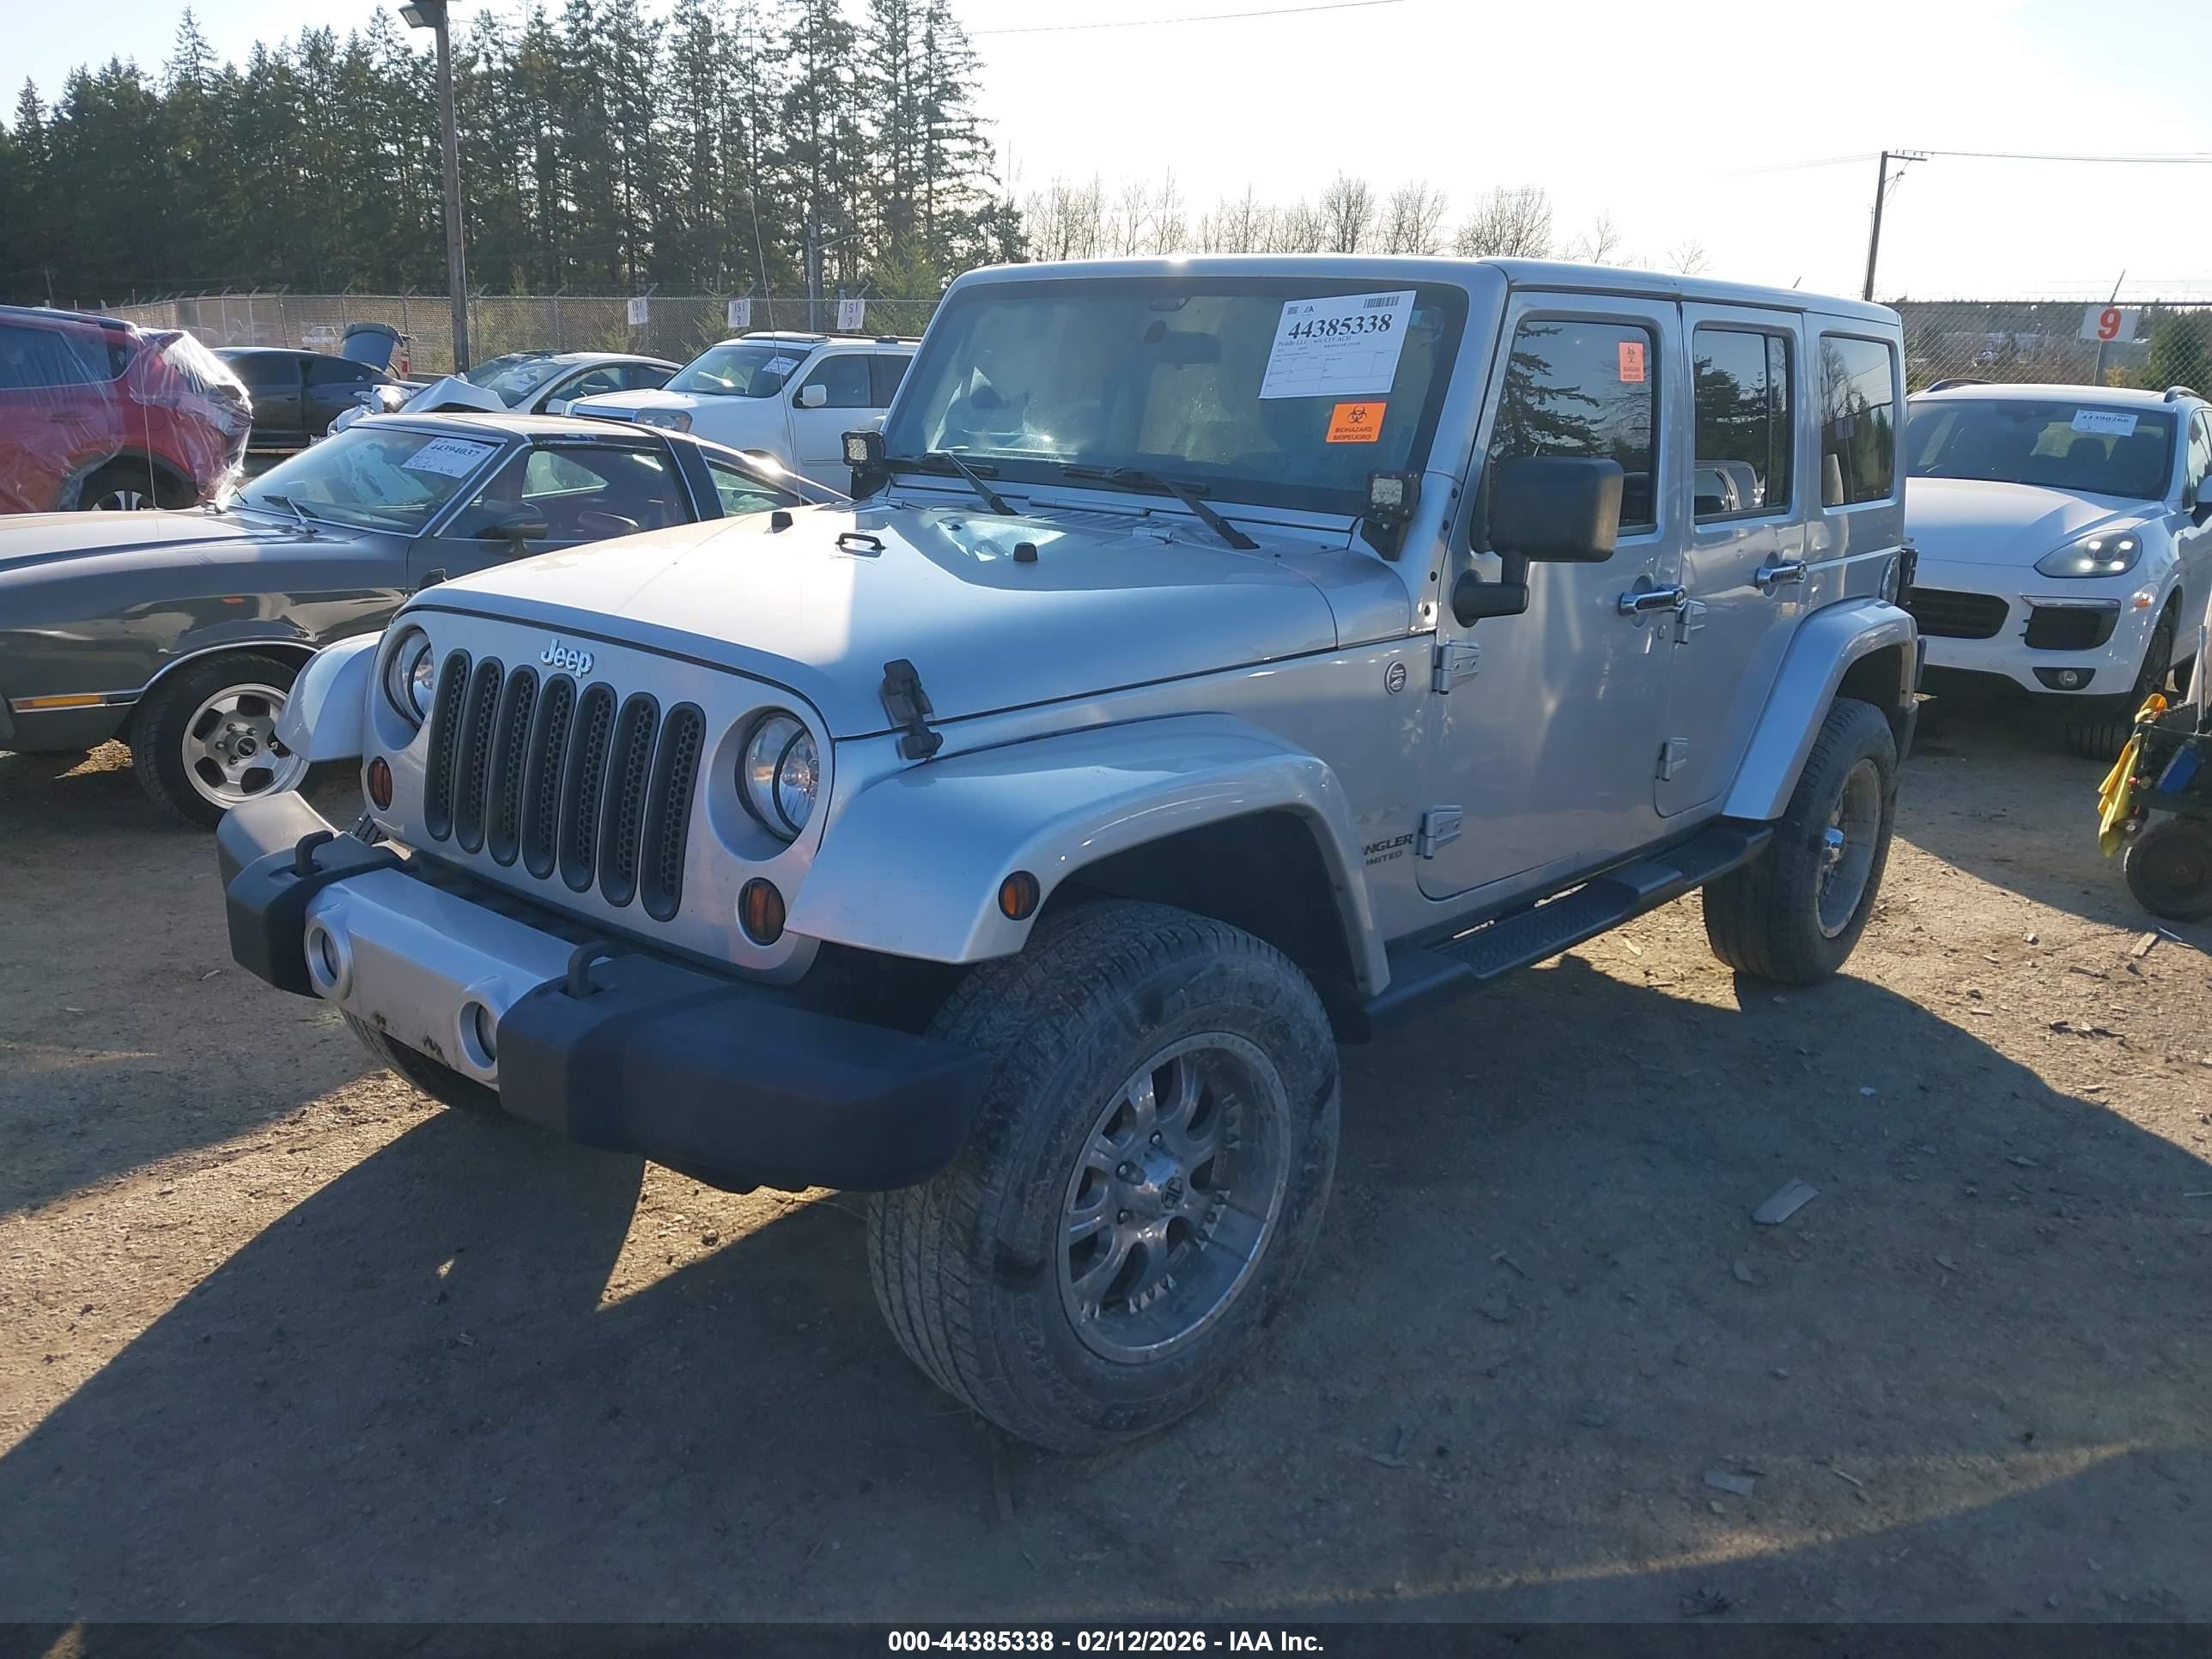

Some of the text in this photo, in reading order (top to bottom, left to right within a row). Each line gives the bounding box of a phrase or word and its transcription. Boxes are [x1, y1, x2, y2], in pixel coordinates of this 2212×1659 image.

[1287, 313, 1393, 340] 44385338
[2097, 307, 2122, 340] 9
[541, 639, 594, 678] Jeep
